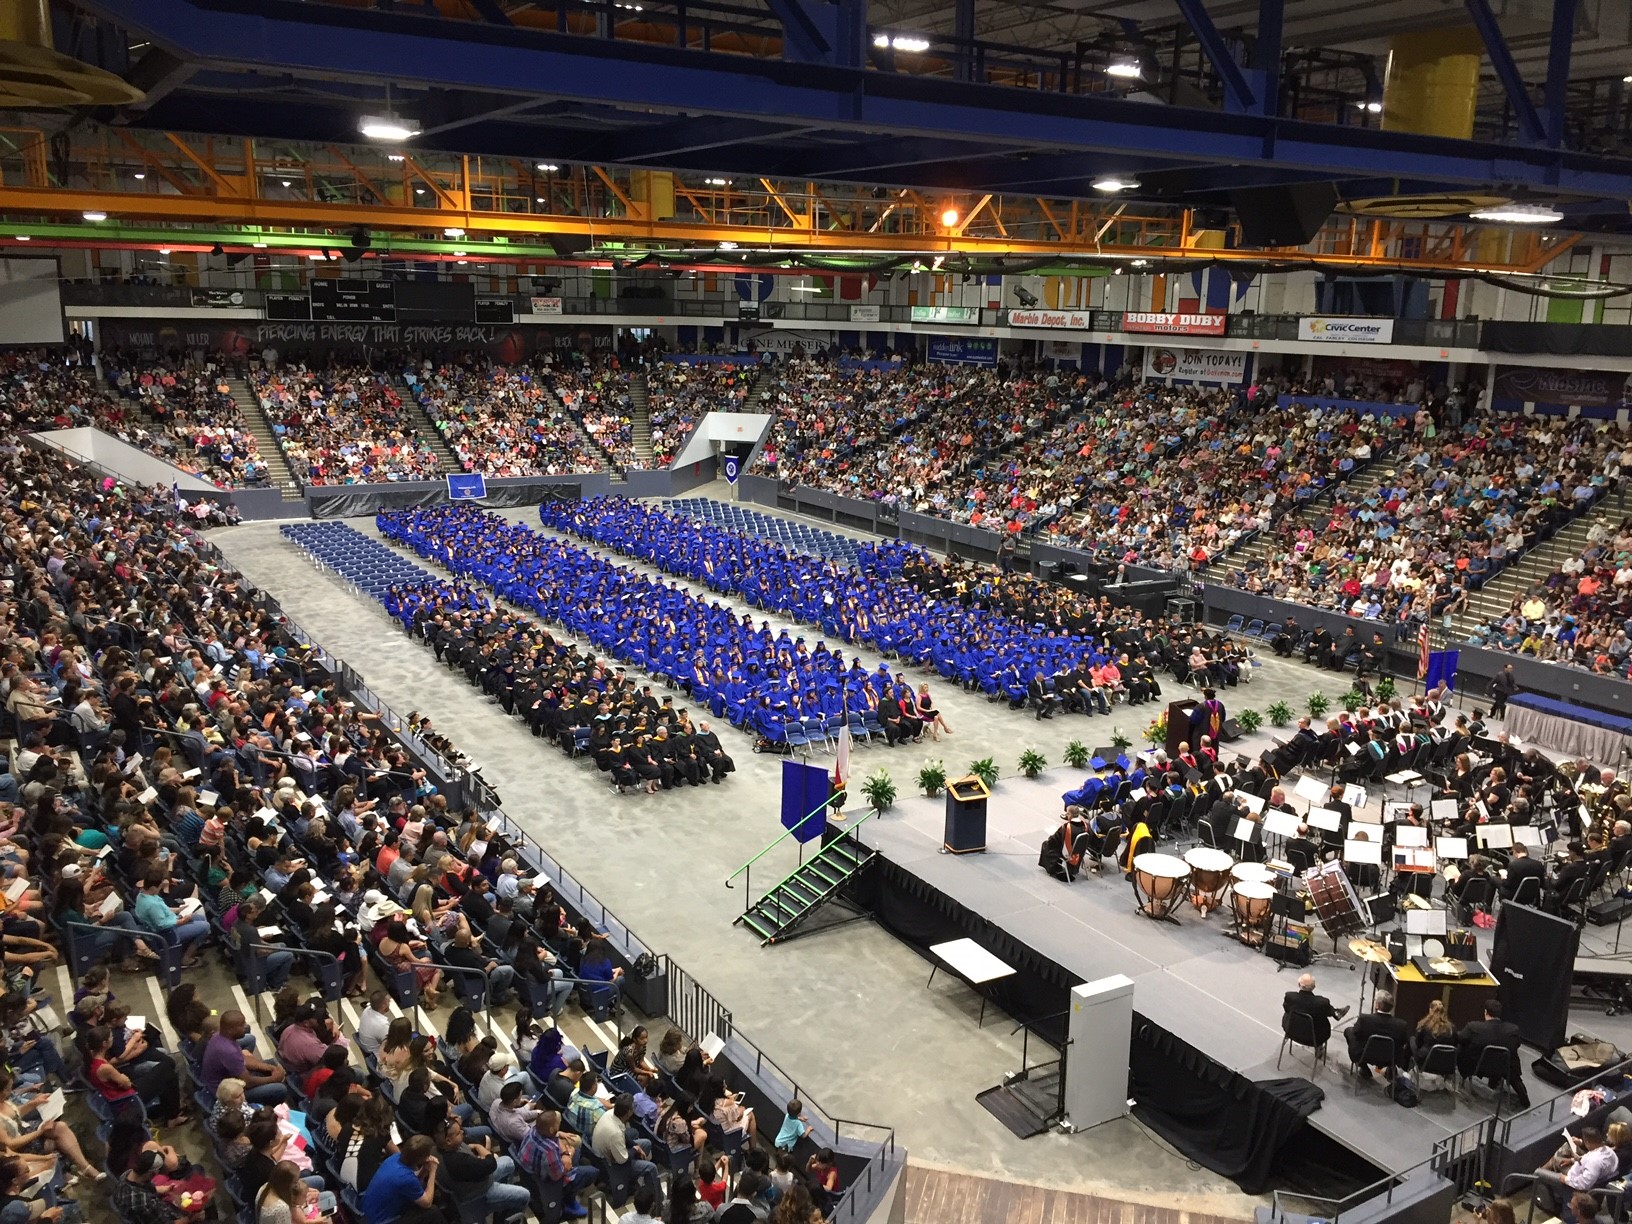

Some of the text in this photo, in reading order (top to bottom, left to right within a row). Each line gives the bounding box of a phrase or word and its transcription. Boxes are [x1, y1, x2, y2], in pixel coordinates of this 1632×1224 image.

[1012, 312, 1085, 328] Marble Depot, Inc.
[1126, 312, 1224, 327] BOBBY DUBY
[257, 323, 316, 343] PIERCING
[320, 323, 369, 343] ENERGY
[372, 325, 401, 343] THAT
[403, 326, 452, 343] STRIKES
[1154, 324, 1188, 333] motors
[1325, 323, 1348, 332] Civic
[1348, 324, 1381, 333] Center
[186, 332, 209, 346] KILLER
[555, 335, 611, 348] BLACK DEATH
[740, 338, 824, 350] GNE MESER
[1182, 354, 1242, 367] JOIN TODAY!
